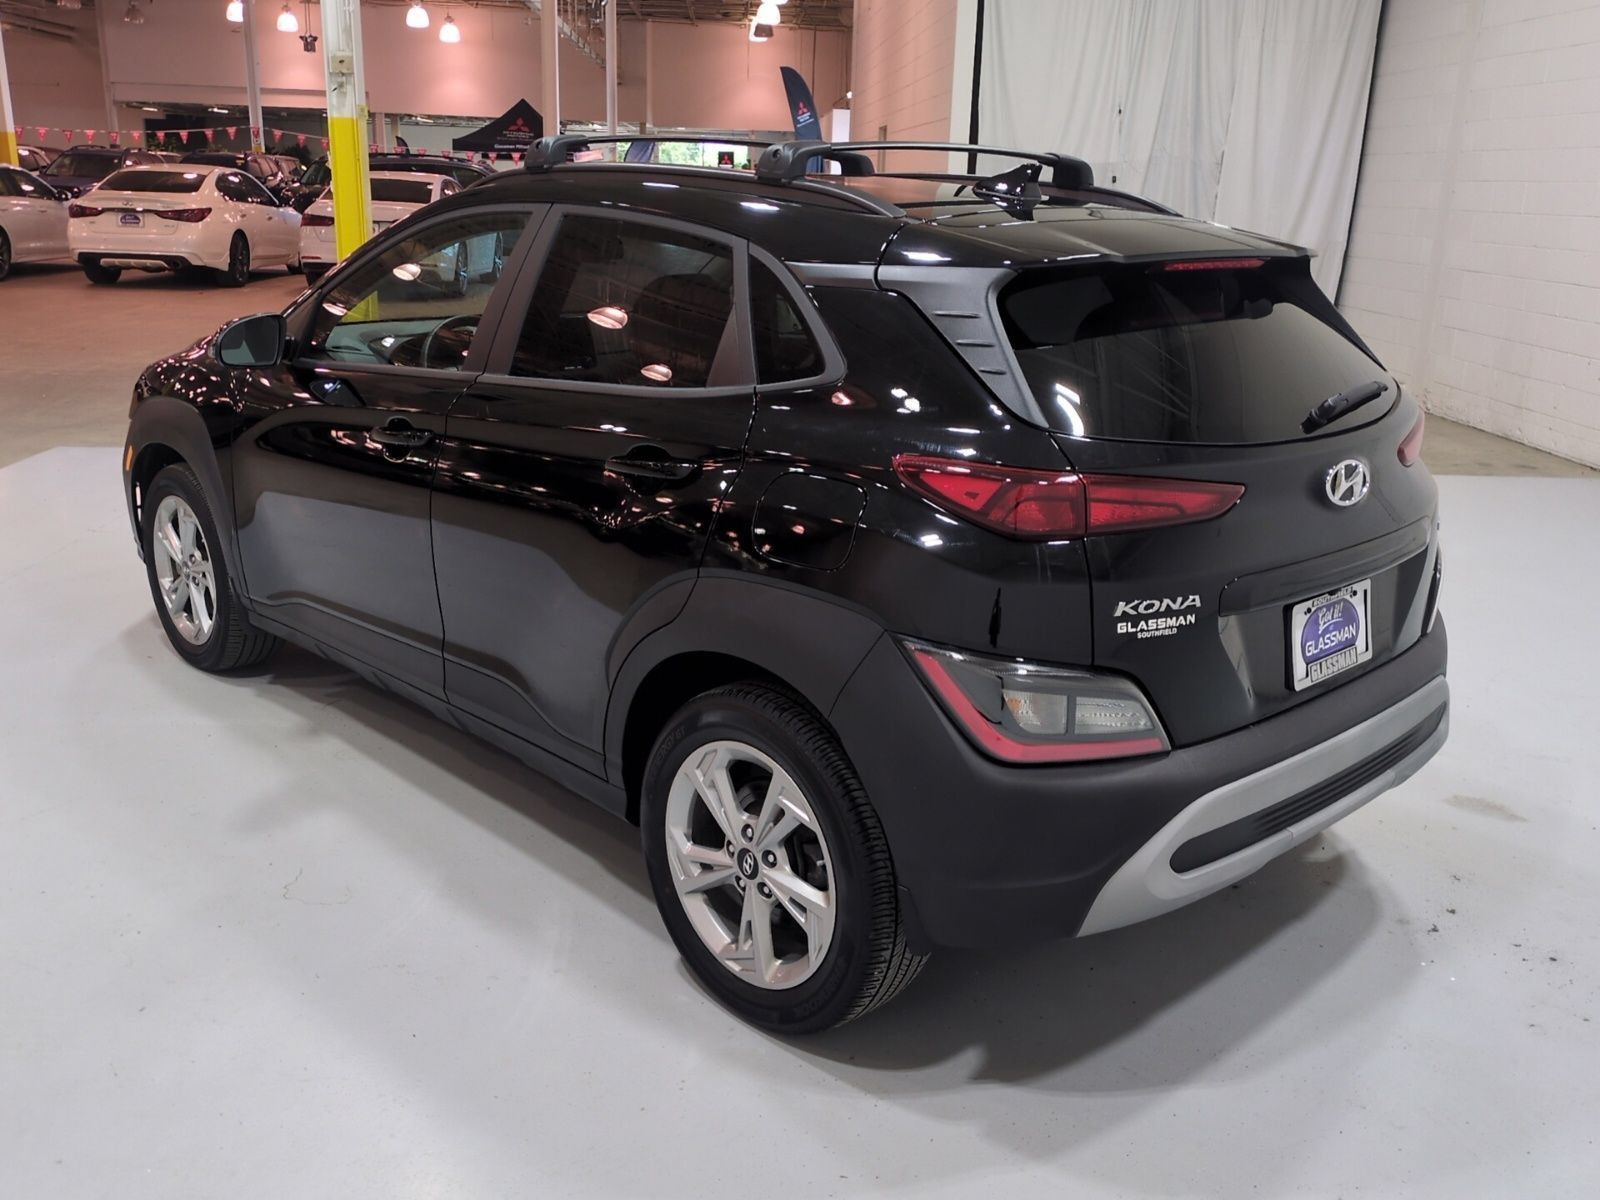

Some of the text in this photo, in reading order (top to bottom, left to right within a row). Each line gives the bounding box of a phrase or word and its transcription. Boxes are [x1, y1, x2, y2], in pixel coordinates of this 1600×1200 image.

[1114, 595, 1201, 617] KONA
[1318, 605, 1333, 625] Got
[1117, 614, 1196, 634] GLASSMAN
[1137, 628, 1177, 639] SOUTHFIELD
[1305, 623, 1356, 656] GLASSMAN
[1311, 647, 1357, 682] GLASSMAN
